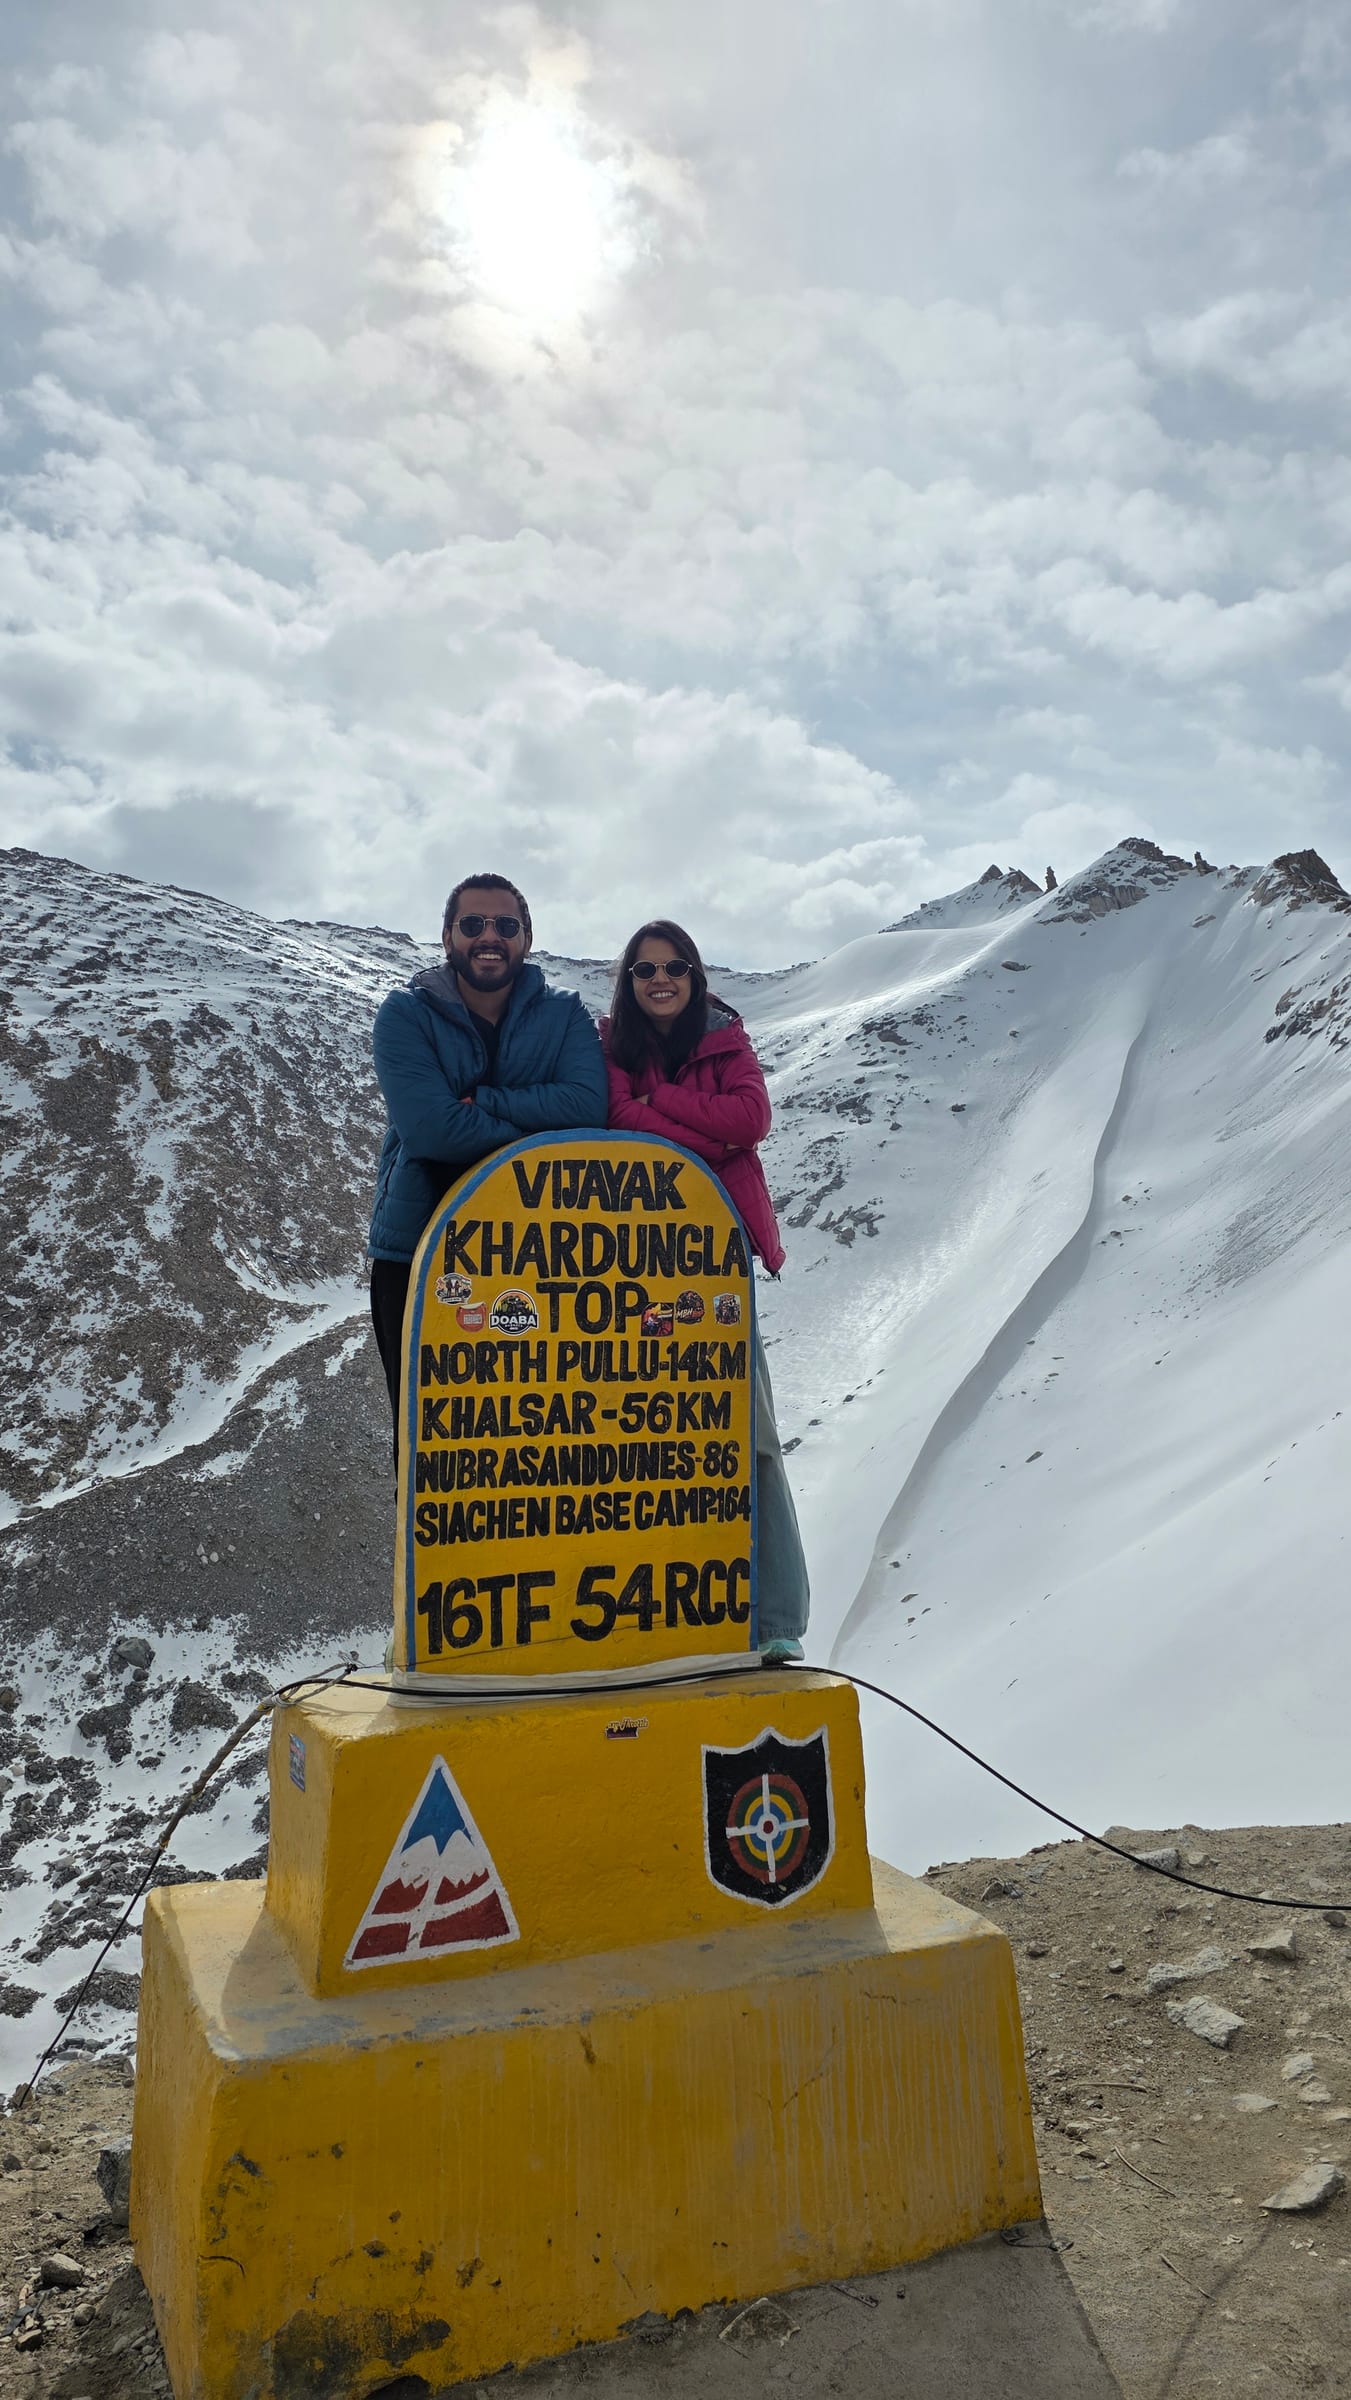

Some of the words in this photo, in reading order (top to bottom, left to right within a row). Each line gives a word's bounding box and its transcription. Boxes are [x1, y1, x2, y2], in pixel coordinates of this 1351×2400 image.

[512, 1160, 686, 1212] VIJAYAK
[443, 1220, 749, 1278] KHARDUNGLA
[491, 1315, 536, 1326] DOABA
[536, 1281, 649, 1334] TOP
[421, 1340, 548, 1386] NORTH
[414, 1496, 550, 1547] SIACHEN
[555, 1492, 631, 1535] BASE
[417, 1570, 555, 1654] 16TF
